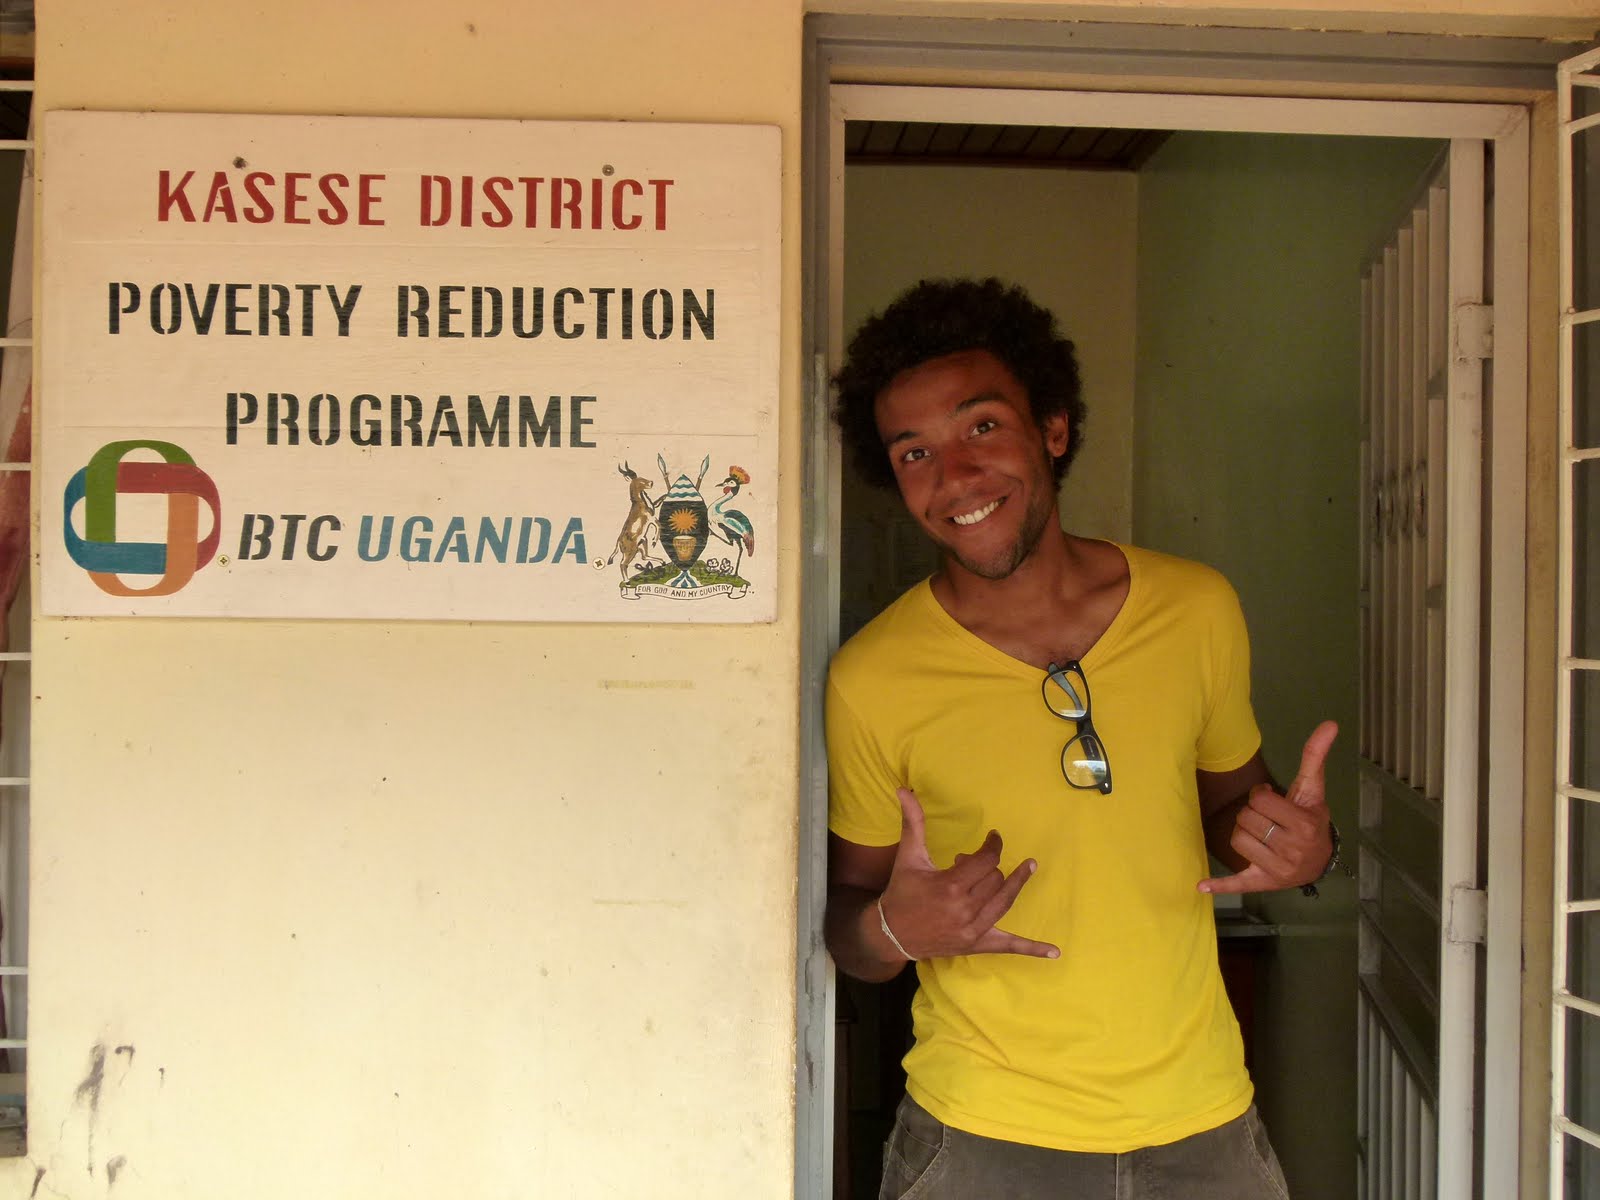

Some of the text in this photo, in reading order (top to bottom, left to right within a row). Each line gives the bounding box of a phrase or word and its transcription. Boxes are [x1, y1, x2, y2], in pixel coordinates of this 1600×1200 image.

[158, 171, 675, 230] KASESE DISTRICT
[109, 282, 715, 340] POVERTY REDUCTION
[226, 393, 596, 448] PROGRAMME
[239, 514, 588, 563] BTC UGANDA
[687, 590, 698, 598] MY
[700, 585, 730, 596] COUNTRY
